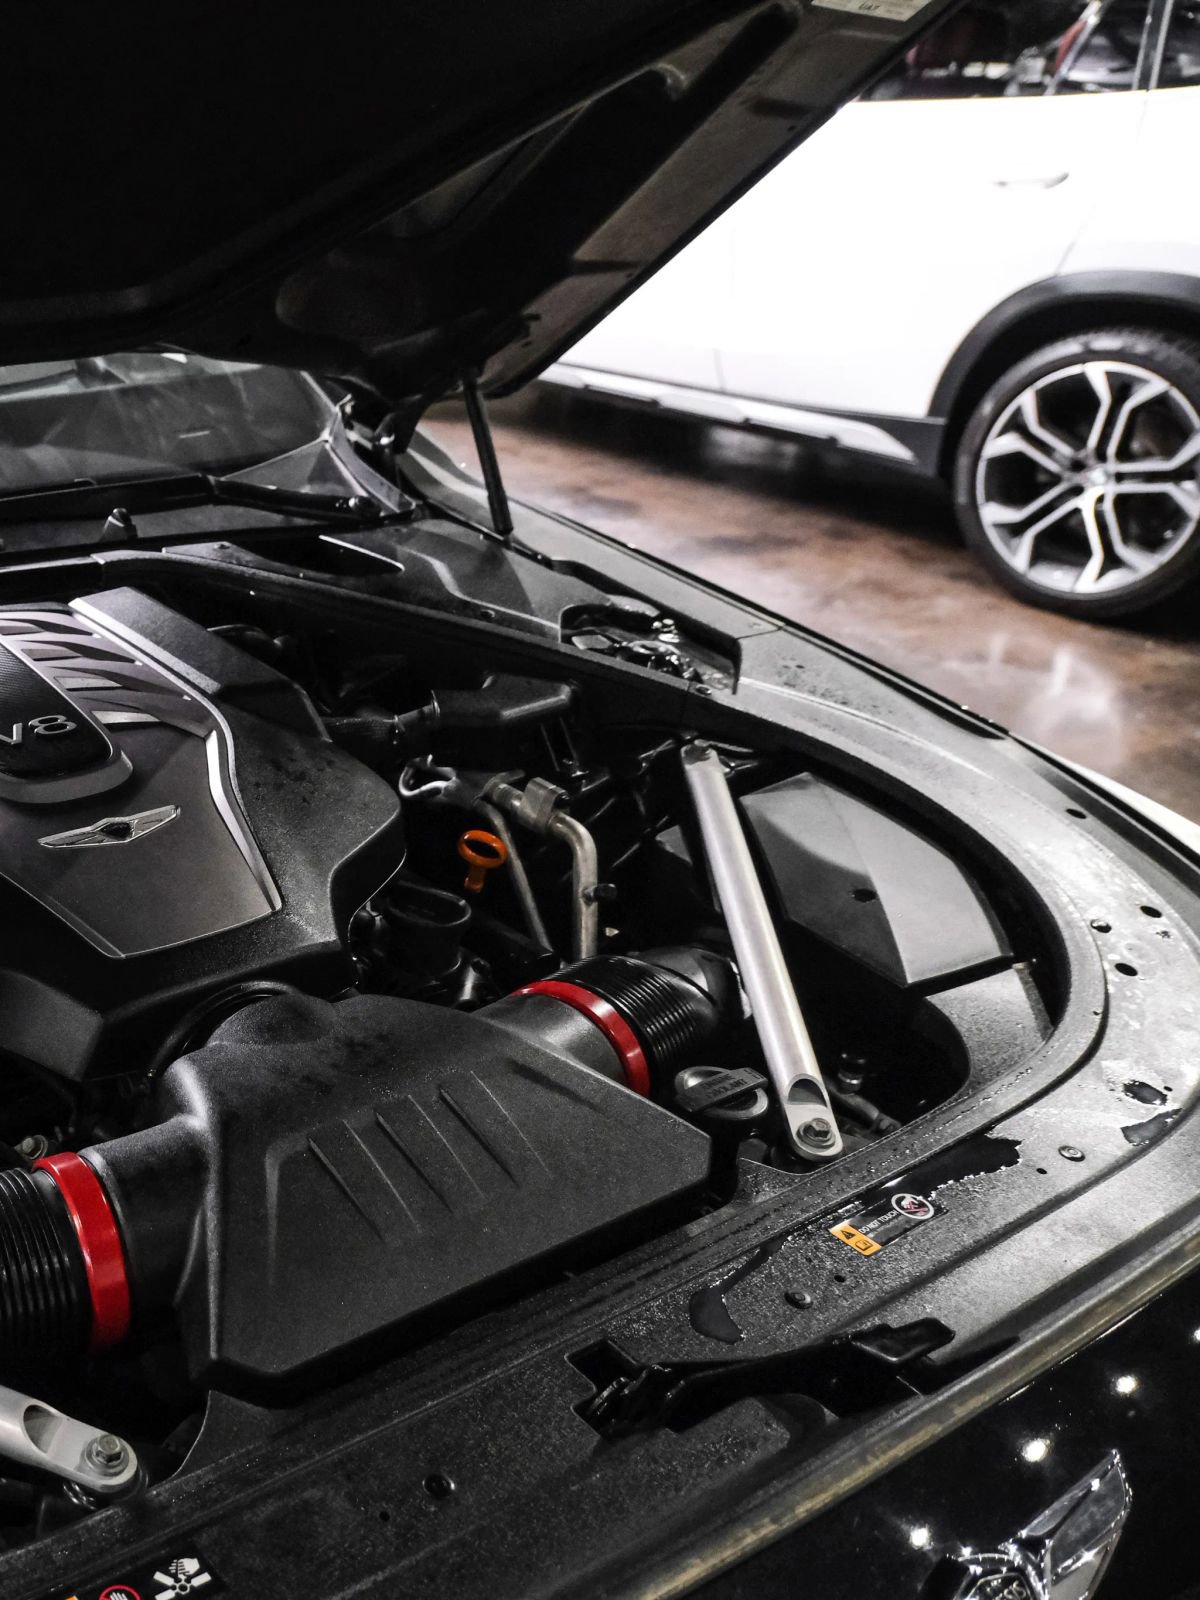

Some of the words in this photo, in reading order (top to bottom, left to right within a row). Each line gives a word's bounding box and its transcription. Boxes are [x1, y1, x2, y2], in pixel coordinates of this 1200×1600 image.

[858, 1226, 870, 1234] DO
[866, 1220, 881, 1230] NOT
[877, 1210, 899, 1223] TOUCH
